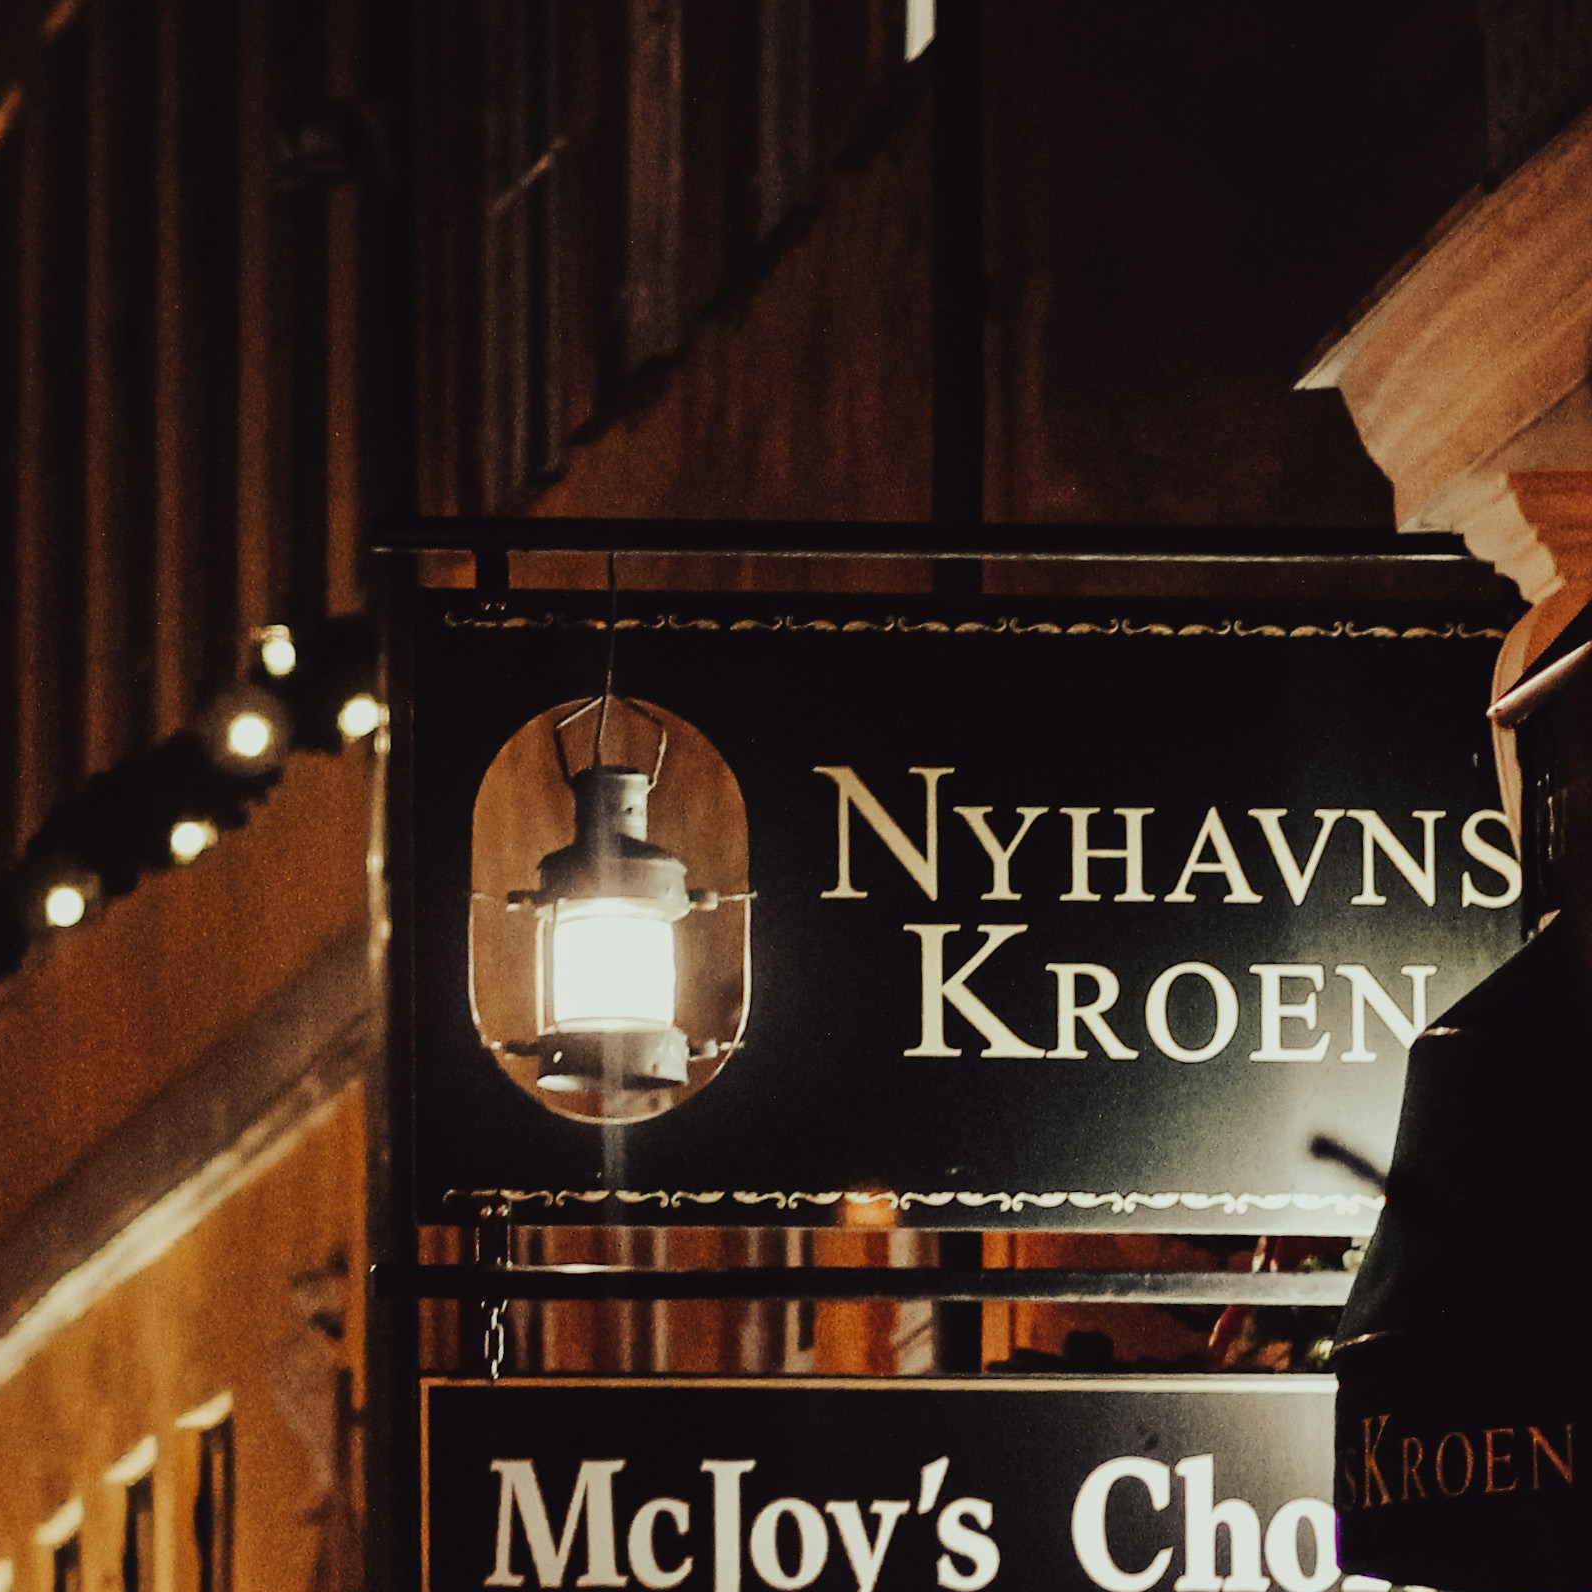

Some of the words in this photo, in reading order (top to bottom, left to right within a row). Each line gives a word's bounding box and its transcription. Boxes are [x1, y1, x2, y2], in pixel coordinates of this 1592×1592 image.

[813, 766, 1524, 909] NYHAVNS
[902, 923, 1438, 1063] KROEN
[1360, 1413, 1574, 1510] KROEN
